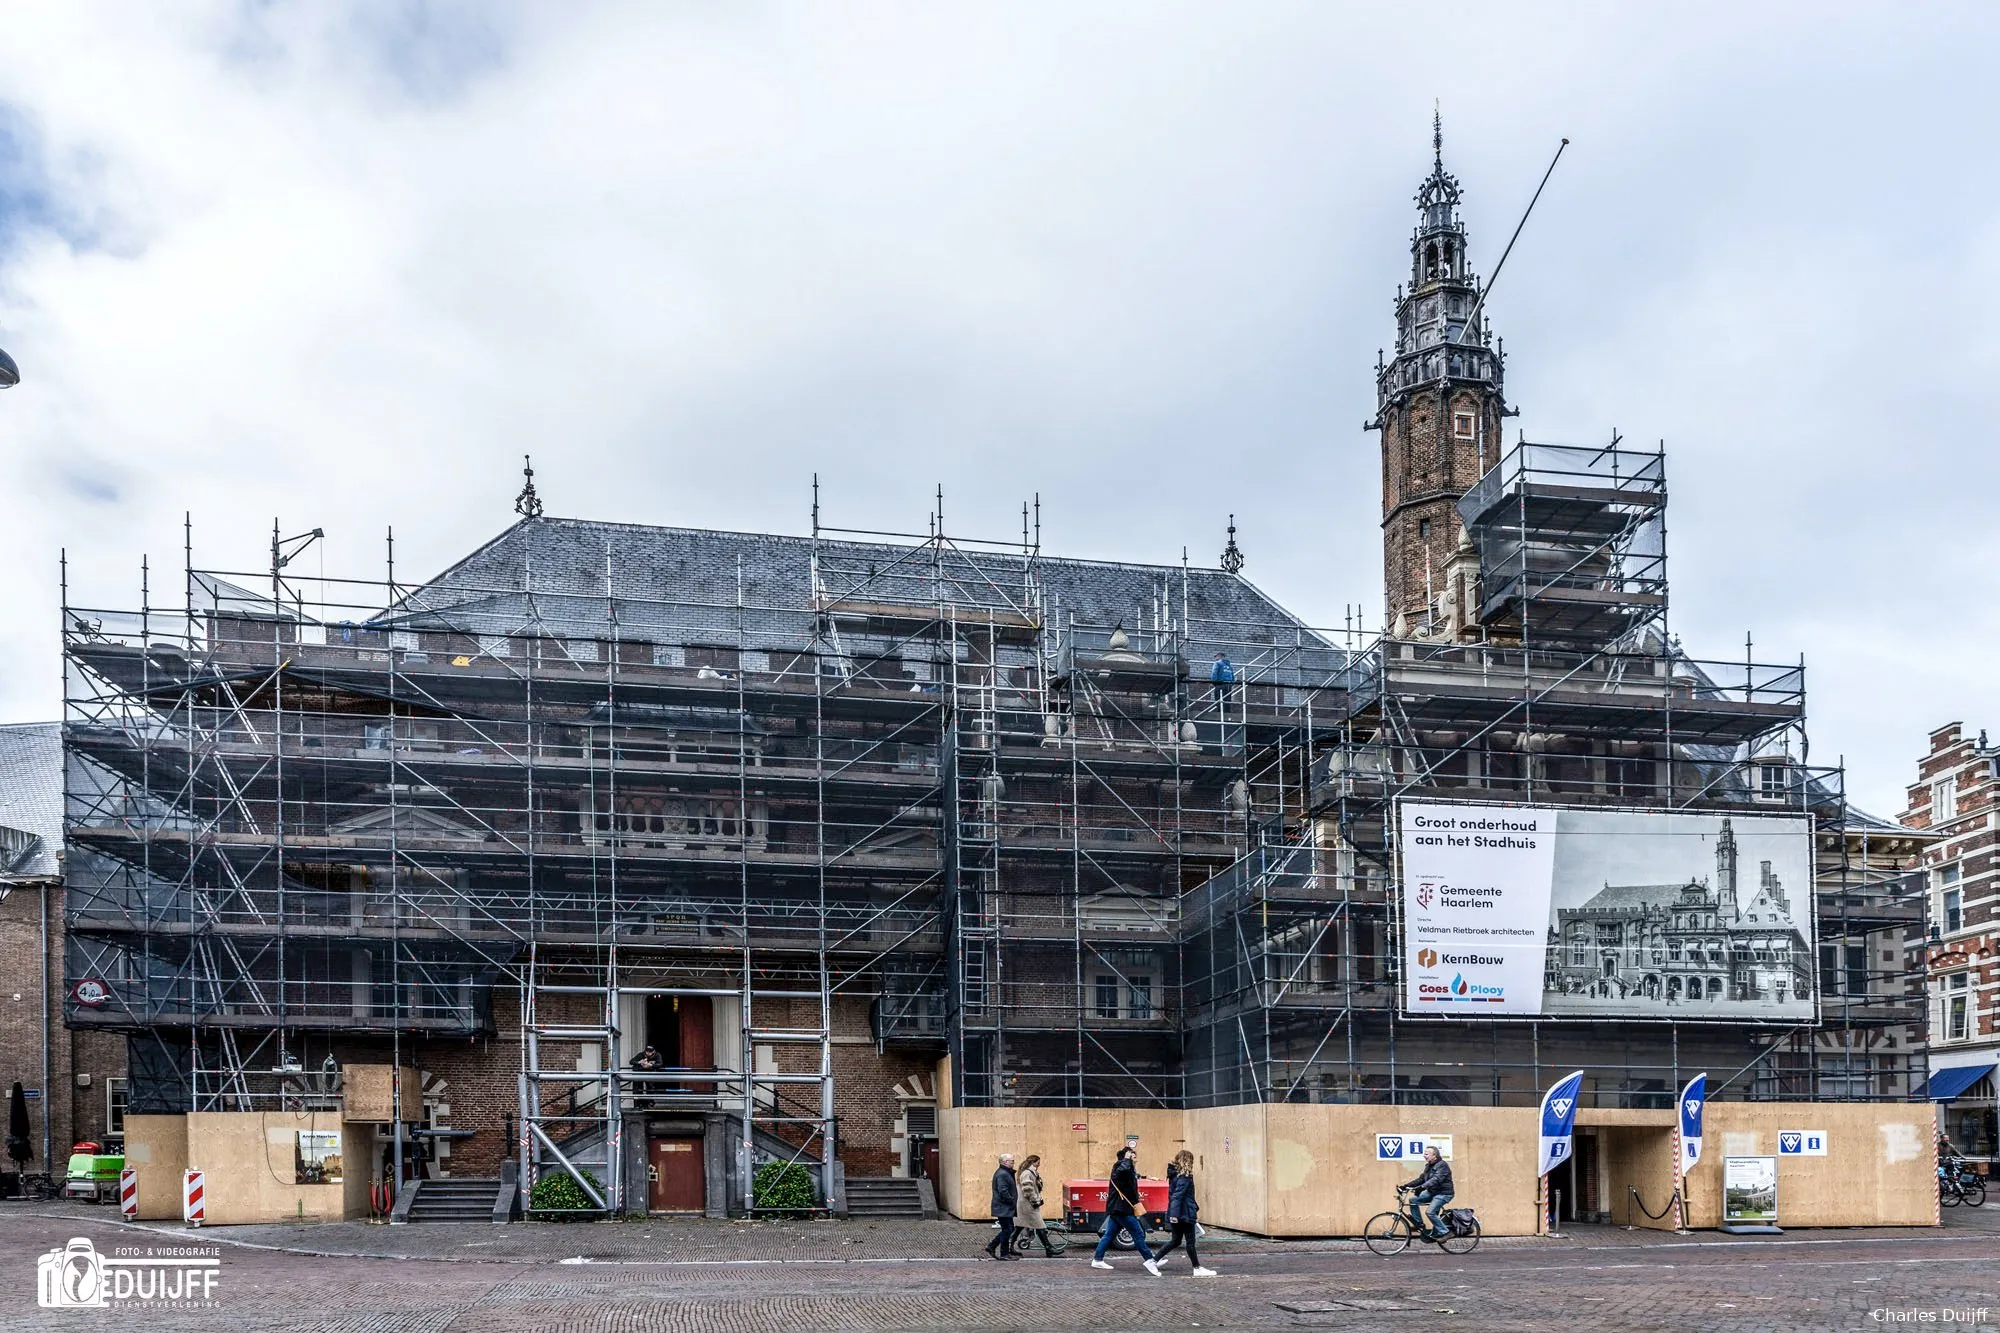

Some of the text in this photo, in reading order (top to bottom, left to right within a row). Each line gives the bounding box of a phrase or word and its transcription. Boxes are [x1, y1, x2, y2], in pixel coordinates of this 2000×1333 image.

[1415, 816, 1537, 832] Groot onderhoud
[1415, 835, 1536, 849] aan het Stadhuis
[1440, 885, 1503, 897] Gemeente
[1441, 897, 1494, 909] Haarlem
[1417, 926, 1535, 936] Veldman Rietbroek architecten
[1442, 954, 1504, 965] KernBouw
[1419, 984, 1449, 994] Goes
[1470, 985, 1504, 996] Plooy
